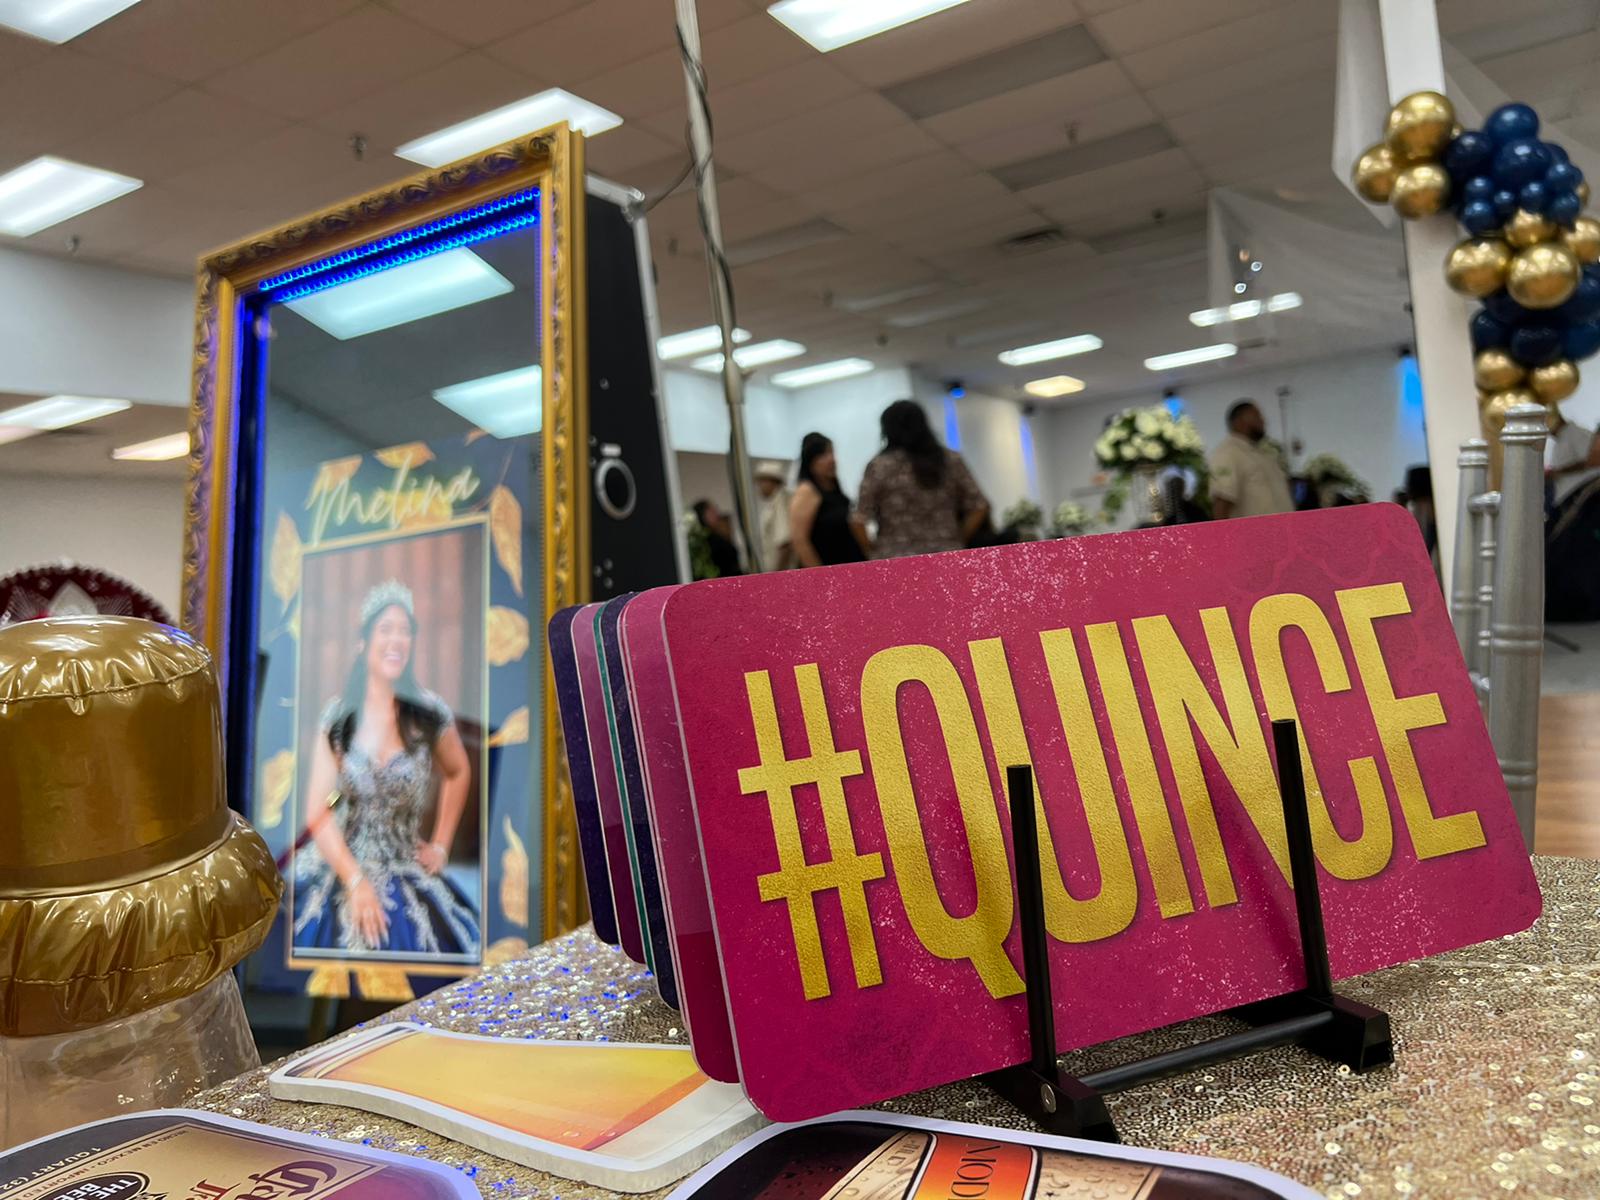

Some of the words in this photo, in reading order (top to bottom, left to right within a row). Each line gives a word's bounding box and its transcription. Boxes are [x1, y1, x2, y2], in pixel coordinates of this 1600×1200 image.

[305, 450, 481, 548] Melina
[737, 581, 1487, 1001] #QUINCE
[31, 1151, 91, 1178] QUART
[88, 1179, 139, 1200] THE
